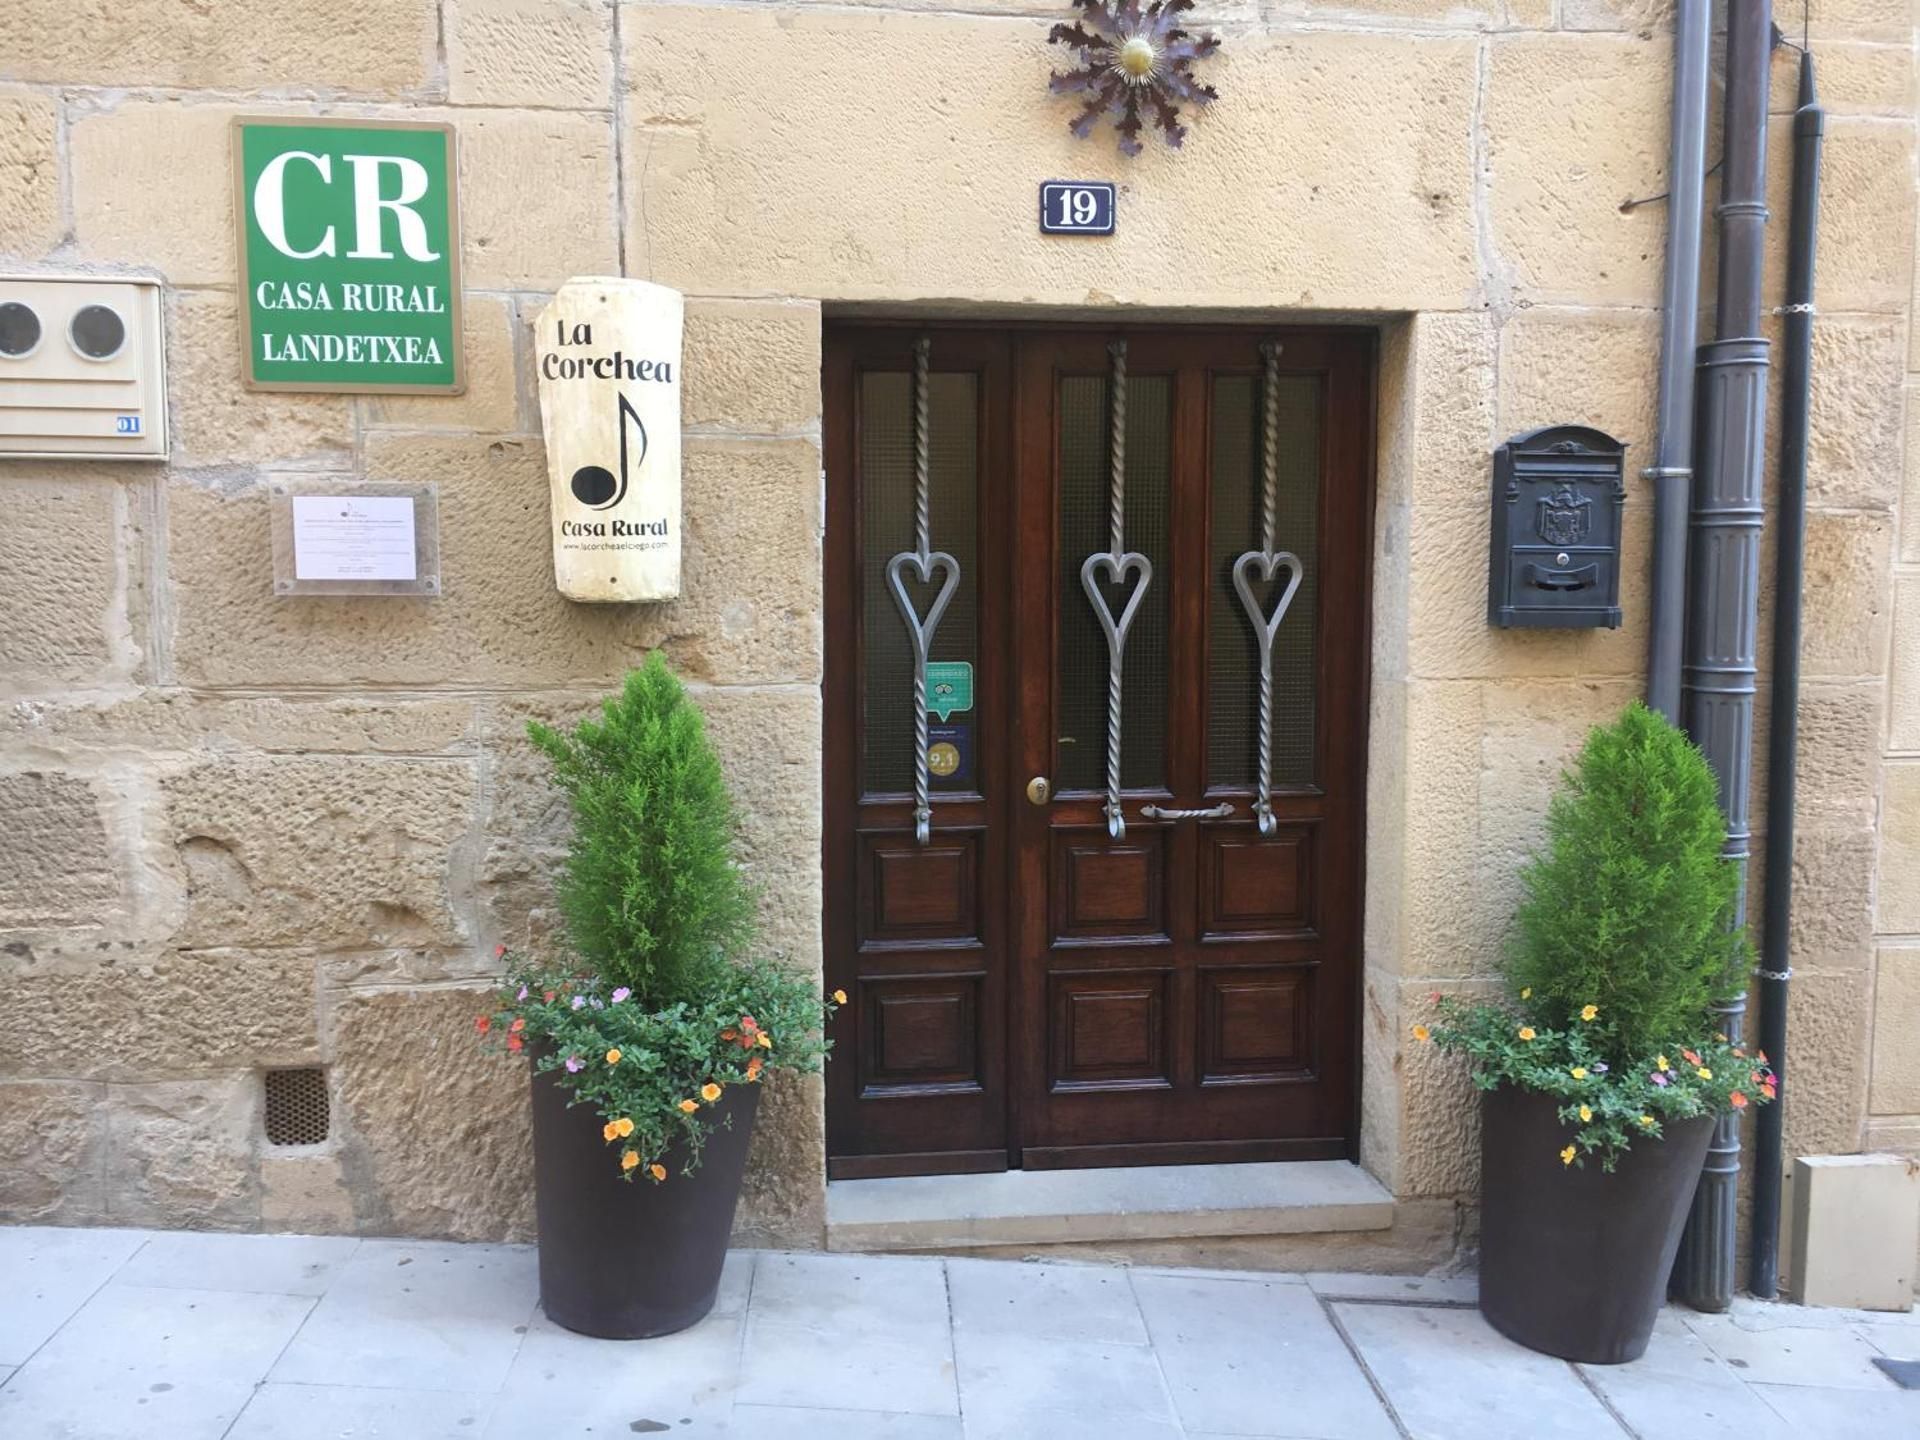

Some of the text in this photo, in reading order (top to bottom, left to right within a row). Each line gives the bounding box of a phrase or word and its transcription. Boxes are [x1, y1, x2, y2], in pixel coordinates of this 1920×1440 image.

[254, 150, 441, 262] CR
[1059, 189, 1098, 225] 19
[256, 280, 445, 313] CASA RURAL
[557, 319, 592, 346] La
[262, 333, 444, 365] LANDETXEA
[542, 350, 673, 383] Corchea
[118, 418, 139, 432] 01
[561, 518, 669, 537] Casa Rural
[930, 752, 954, 767] 9.1
